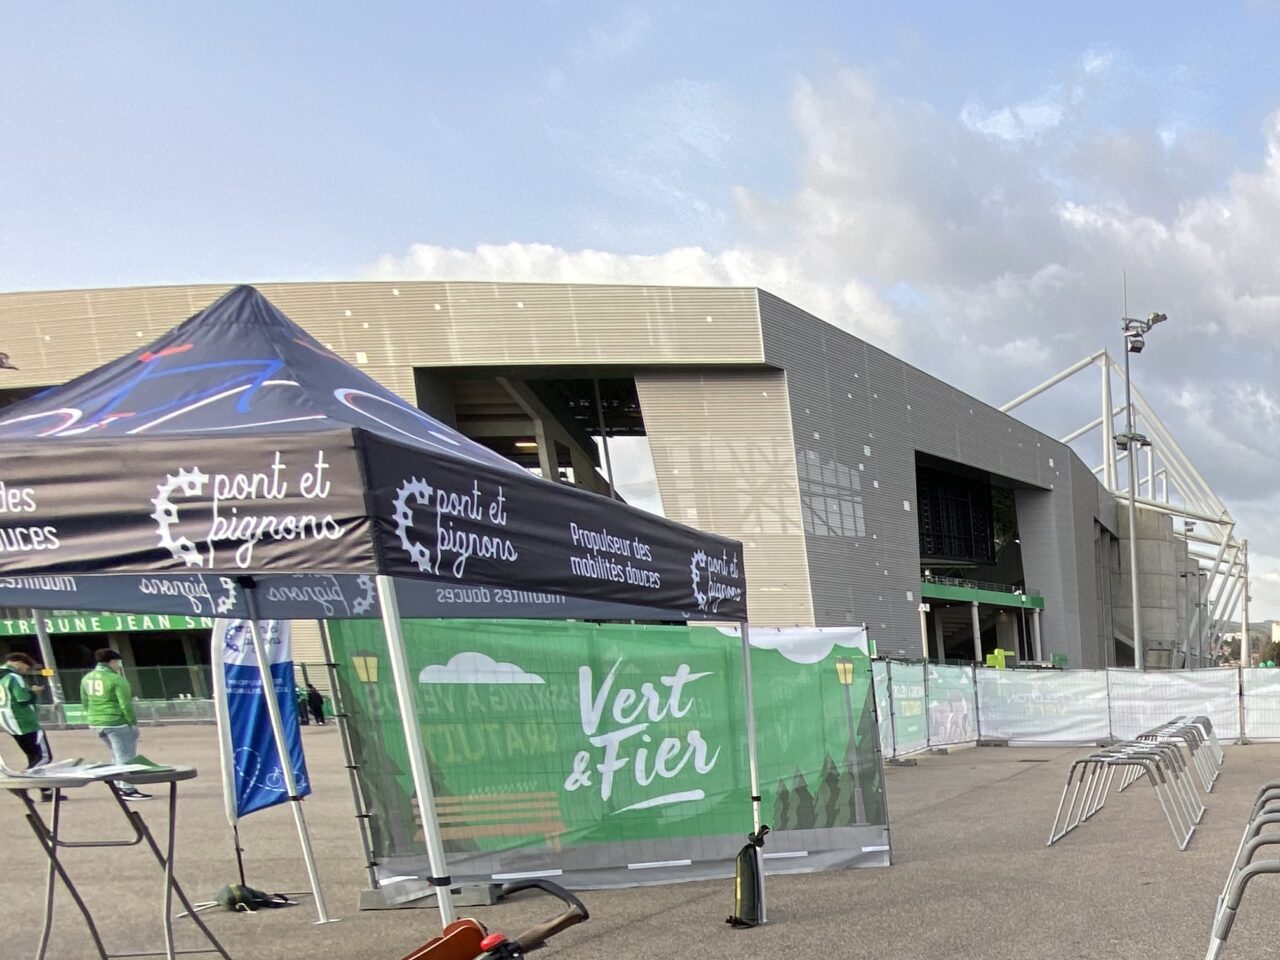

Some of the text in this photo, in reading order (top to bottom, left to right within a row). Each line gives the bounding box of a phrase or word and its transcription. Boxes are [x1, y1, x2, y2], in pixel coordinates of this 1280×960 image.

[213, 450, 331, 500] pont et
[436, 480, 507, 526] pont et
[0, 526, 60, 552] uces
[207, 507, 346, 569] pignons
[435, 521, 519, 579] pignons
[569, 522, 652, 563] Propulseur des
[570, 553, 661, 589] mobilités douces
[707, 549, 739, 579] pont et
[705, 577, 742, 614] pignons
[3, 617, 101, 635] TRBUNE
[115, 614, 172, 631] JEAN
[86, 679, 104, 696] 19
[578, 656, 715, 736] Vert
[564, 722, 722, 802] & Fier
